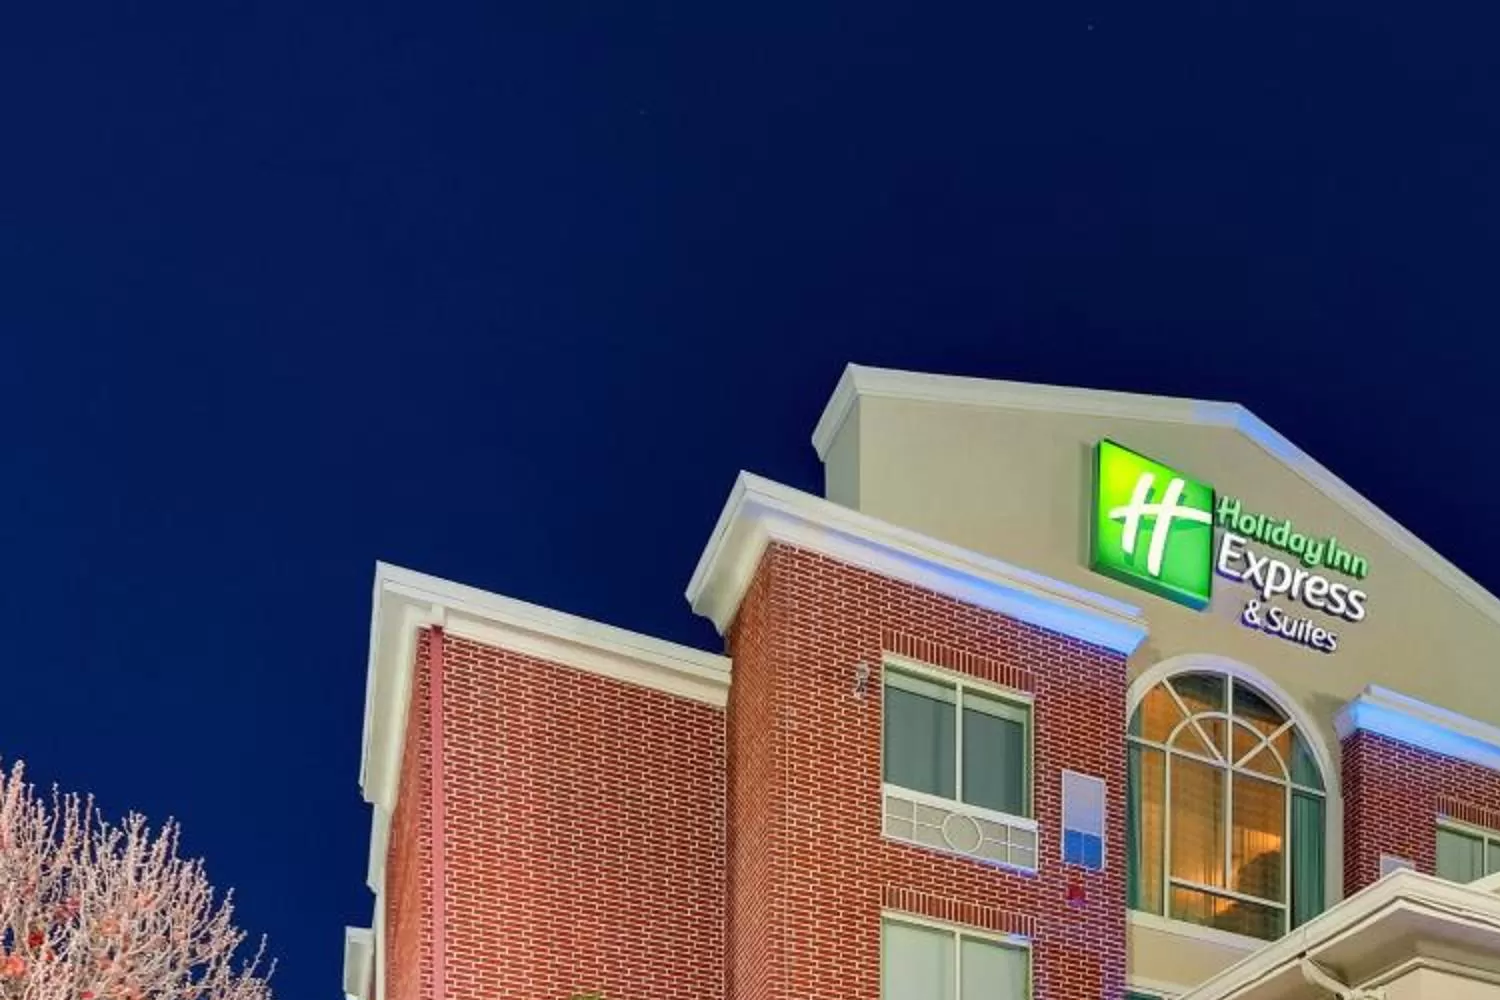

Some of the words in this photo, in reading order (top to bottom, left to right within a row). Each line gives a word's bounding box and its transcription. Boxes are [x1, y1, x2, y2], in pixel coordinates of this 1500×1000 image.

[1217, 496, 1325, 565] Holiday
[1325, 536, 1369, 577] Inn
[1217, 532, 1367, 621] Express
[1244, 599, 1262, 626] &
[1267, 606, 1338, 651] Suites
